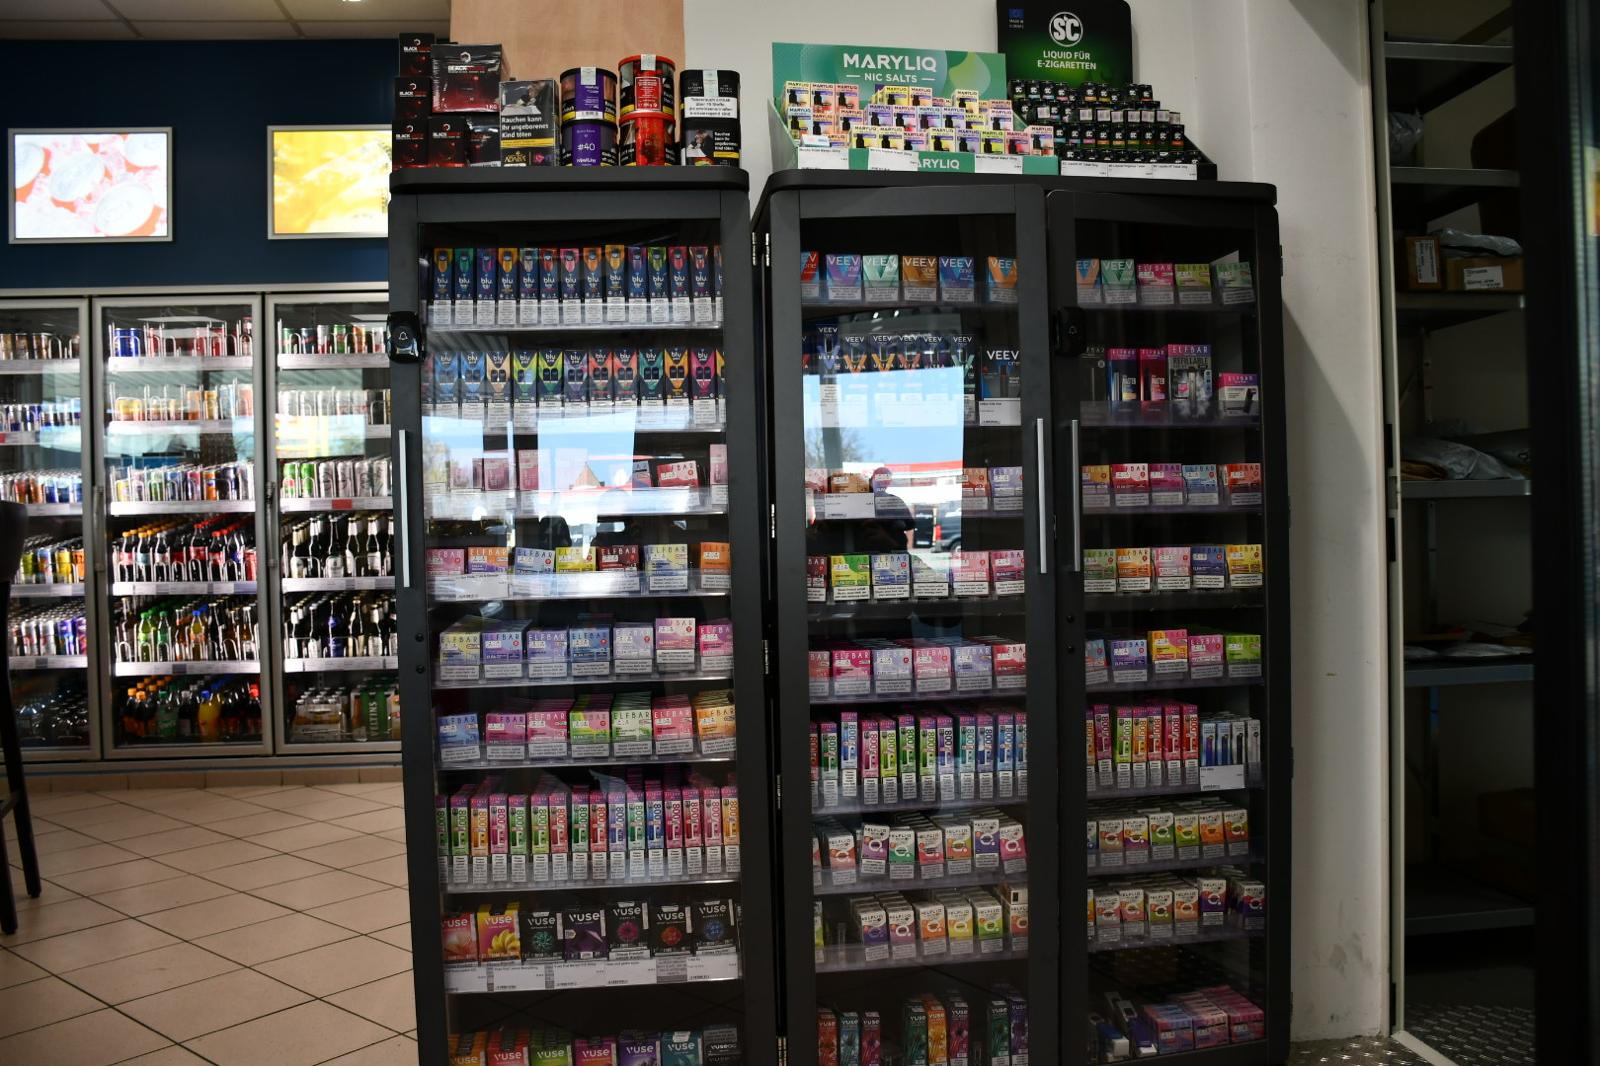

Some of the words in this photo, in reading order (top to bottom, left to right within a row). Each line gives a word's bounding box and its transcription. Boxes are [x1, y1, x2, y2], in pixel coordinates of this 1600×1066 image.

[1053, 15, 1080, 42] SC
[1043, 51, 1072, 60] LIQUID
[1074, 50, 1091, 60] FÜR
[843, 53, 937, 72] MARYLIQ
[1037, 60, 1097, 70] E-ZIGARETTEN
[864, 73, 883, 81] NIC
[885, 74, 917, 83] SALTS
[917, 159, 960, 169] ARYLIQ
[827, 257, 859, 266] VEEV
[864, 257, 898, 266] VEEV
[904, 257, 936, 266] VEEV
[941, 258, 972, 268] VEEV
[1077, 261, 1097, 270] EEV
[1104, 261, 1134, 271] VEEV
[1172, 346, 1208, 354] ELFBAR
[986, 351, 1020, 360] VEEV
[529, 633, 565, 641] ELFBAR
[810, 653, 828, 661] BAR
[834, 652, 869, 660] ELFBAR
[369, 702, 379, 736] VELTINS
[613, 712, 650, 720] ELFBAR
